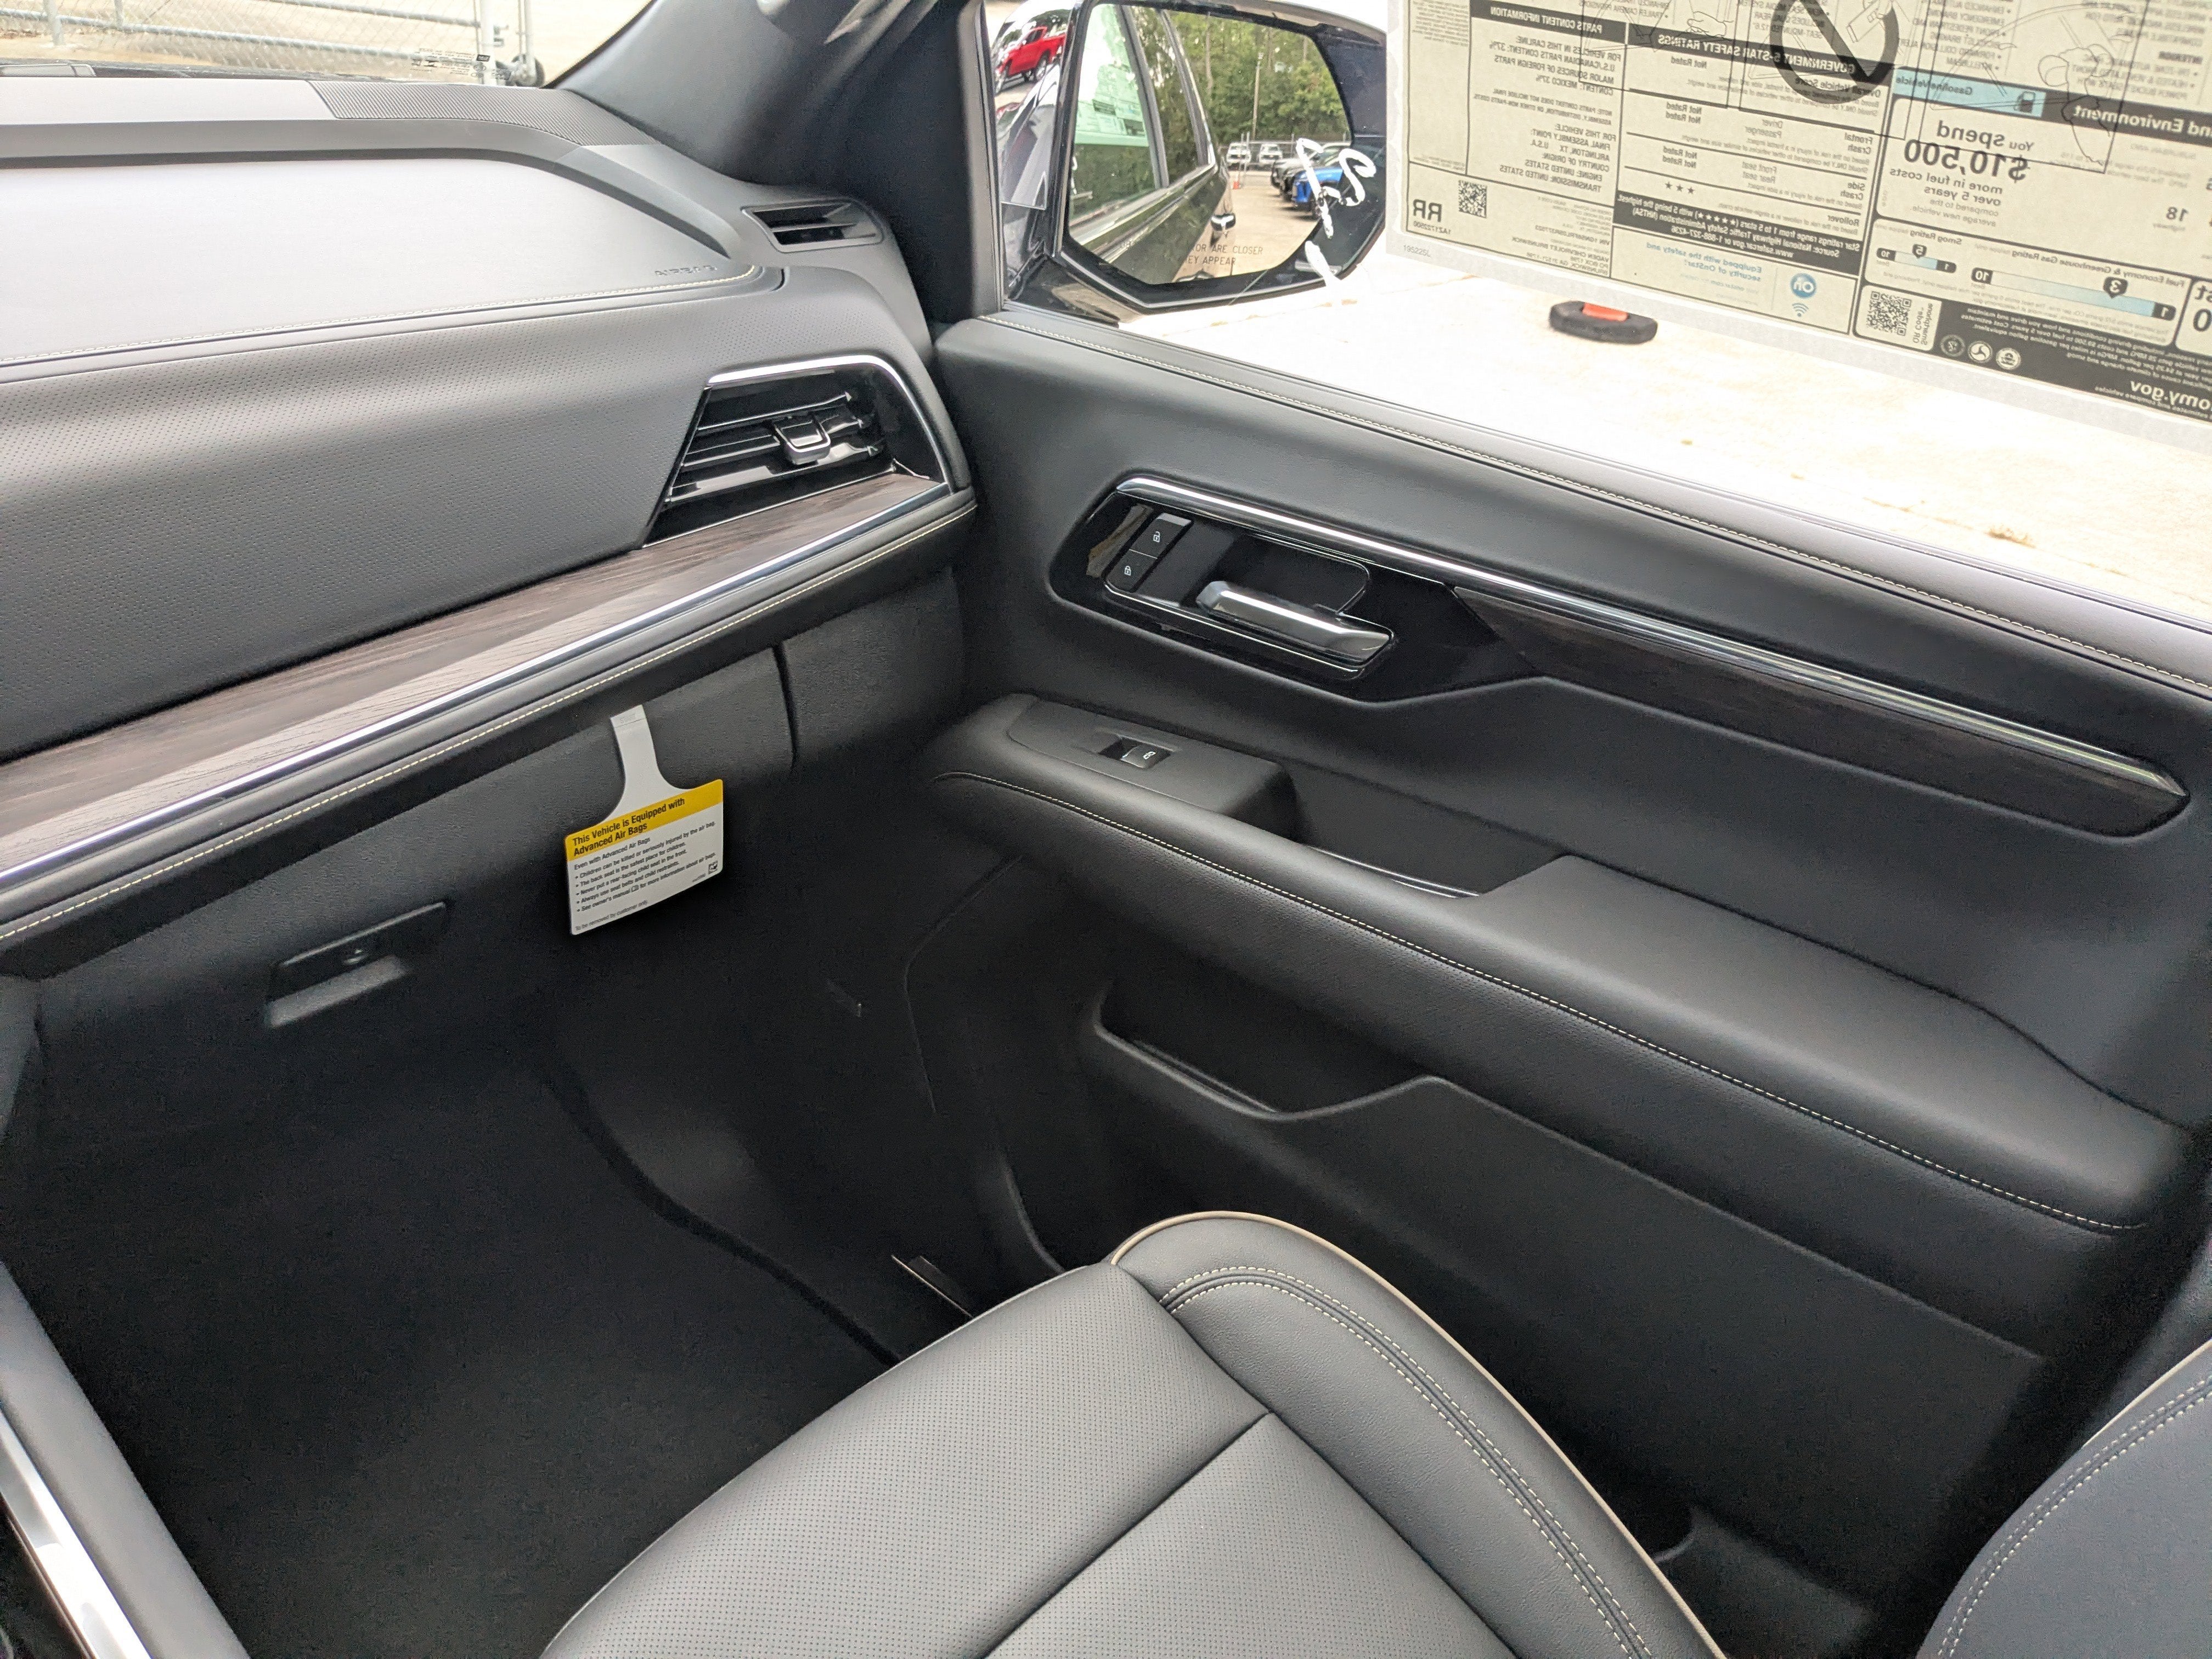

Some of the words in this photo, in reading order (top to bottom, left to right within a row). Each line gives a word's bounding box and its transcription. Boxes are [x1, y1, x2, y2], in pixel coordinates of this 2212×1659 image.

[1202, 256, 1236, 265] APPEAR
[1211, 244, 1228, 253] ARE
[1232, 245, 1263, 255] CLOSER
[573, 834, 589, 846] This
[592, 823, 620, 838] Vehicle
[622, 819, 629, 827] is
[631, 804, 666, 824] Equipped
[668, 798, 685, 810] with
[574, 834, 612, 856] Advanced
[615, 831, 625, 840] Air
[628, 823, 647, 836] Bags
[574, 862, 587, 870] Even
[589, 856, 601, 865] with
[602, 845, 627, 859] Advanced
[637, 837, 650, 846] Bags
[579, 867, 601, 878] Children
[621, 853, 635, 862] killed
[642, 842, 664, 854] seriously
[665, 834, 682, 845] injured
[590, 874, 602, 883] back
[630, 858, 644, 868] safest
[645, 853, 658, 861] place
